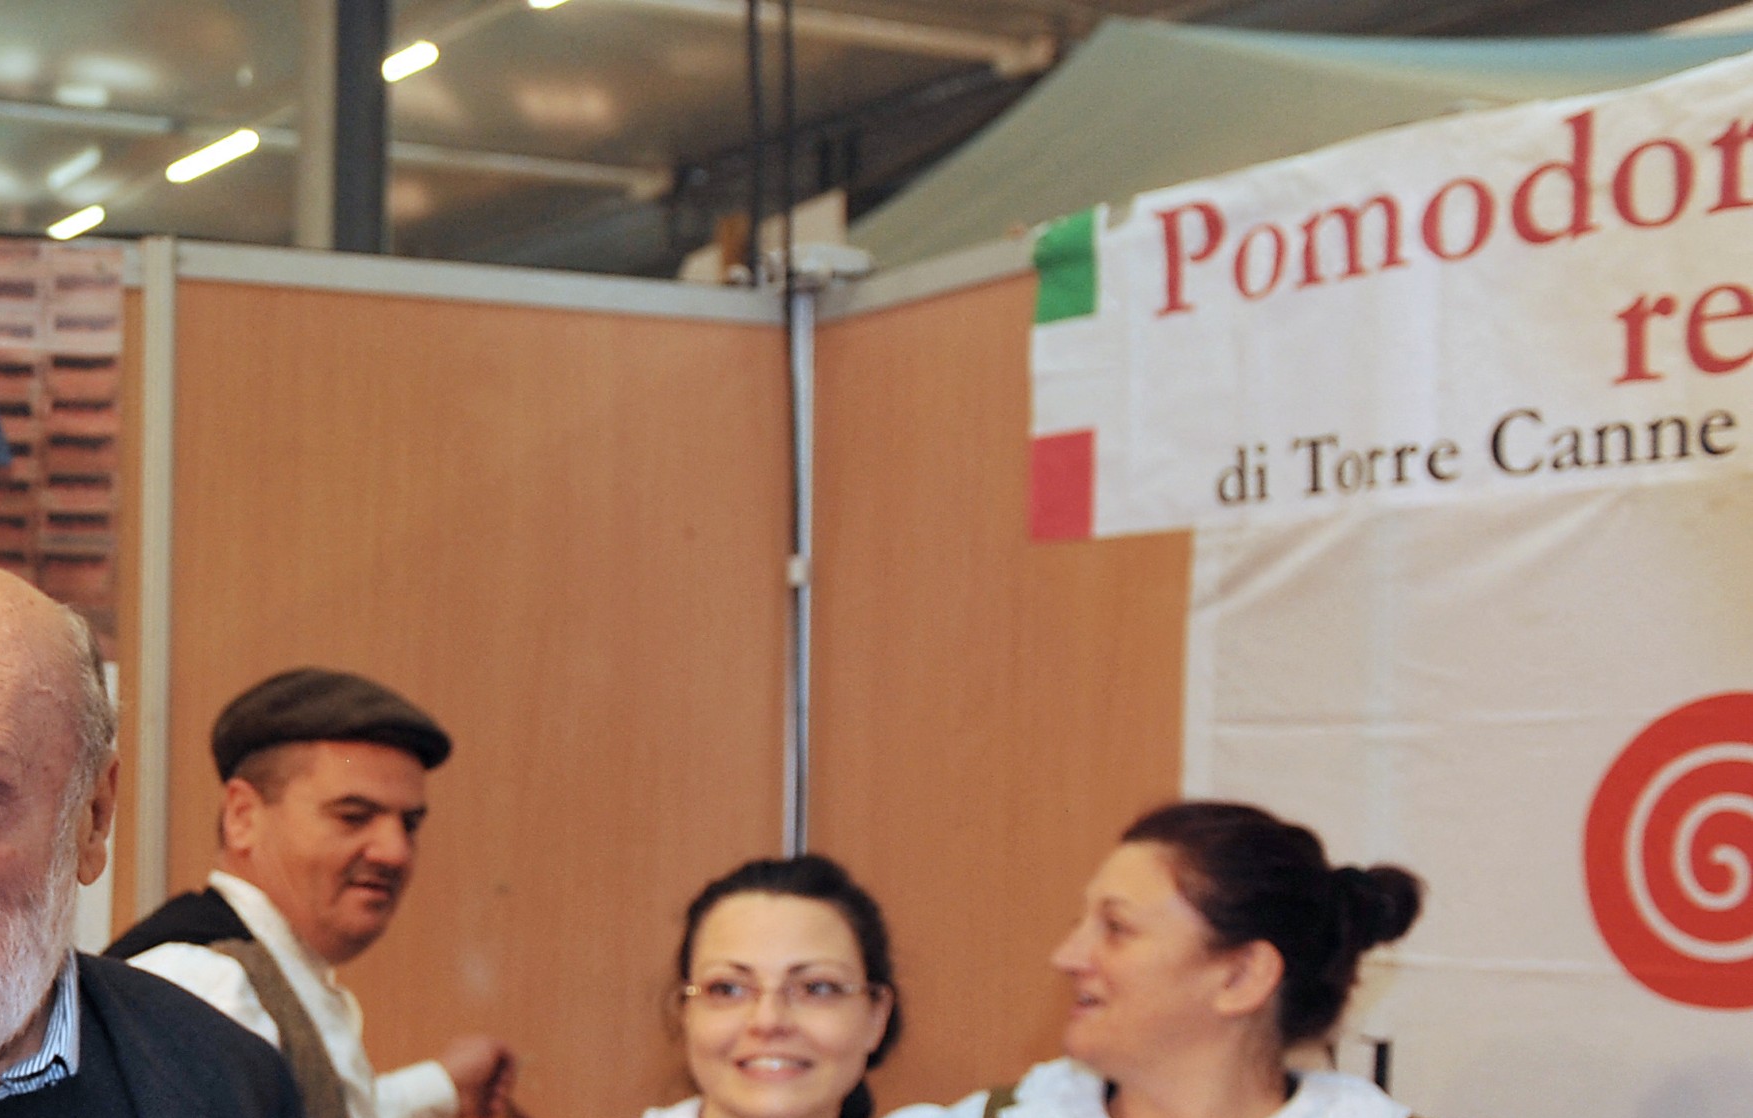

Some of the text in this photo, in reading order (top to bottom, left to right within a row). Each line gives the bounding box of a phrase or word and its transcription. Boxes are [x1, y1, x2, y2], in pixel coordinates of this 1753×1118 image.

[1216, 407, 1737, 507] di Torre Canne
